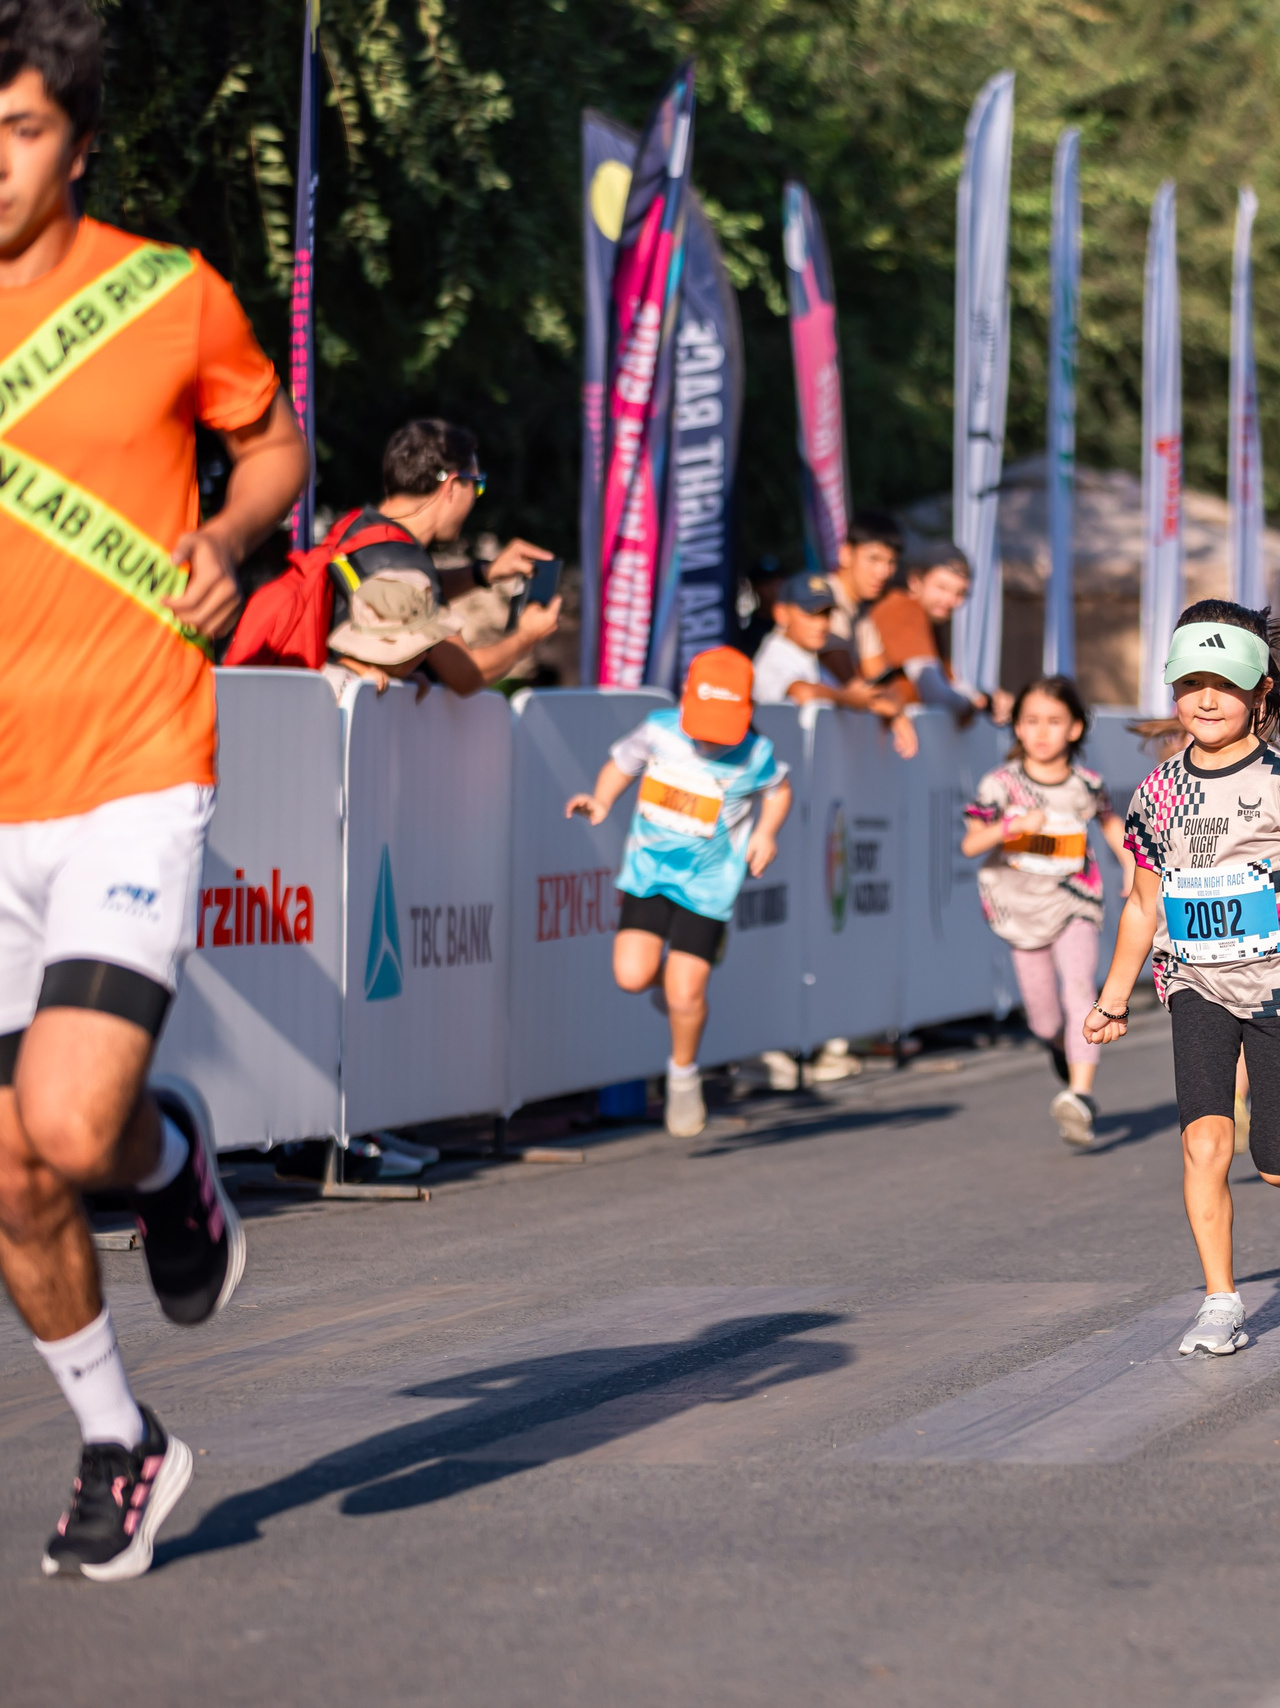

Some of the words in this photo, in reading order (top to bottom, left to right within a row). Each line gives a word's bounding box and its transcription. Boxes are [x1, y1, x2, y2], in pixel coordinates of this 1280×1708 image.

[32, 303, 105, 374] LAB
[15, 471, 92, 539] LAB
[91, 525, 169, 593] RUN
[1184, 817, 1229, 836] BUKHARA
[1189, 835, 1219, 854] NIGHT
[1177, 876, 1202, 889] BUKHARA
[1203, 875, 1225, 889] NIGHT
[1226, 873, 1245, 887] RACE
[1191, 853, 1217, 868] RACE
[196, 867, 316, 949] rzinka
[536, 866, 623, 943] EPIGU
[1184, 898, 1246, 939] 2092
[410, 907, 444, 968] TBC
[447, 904, 494, 967] BANK
